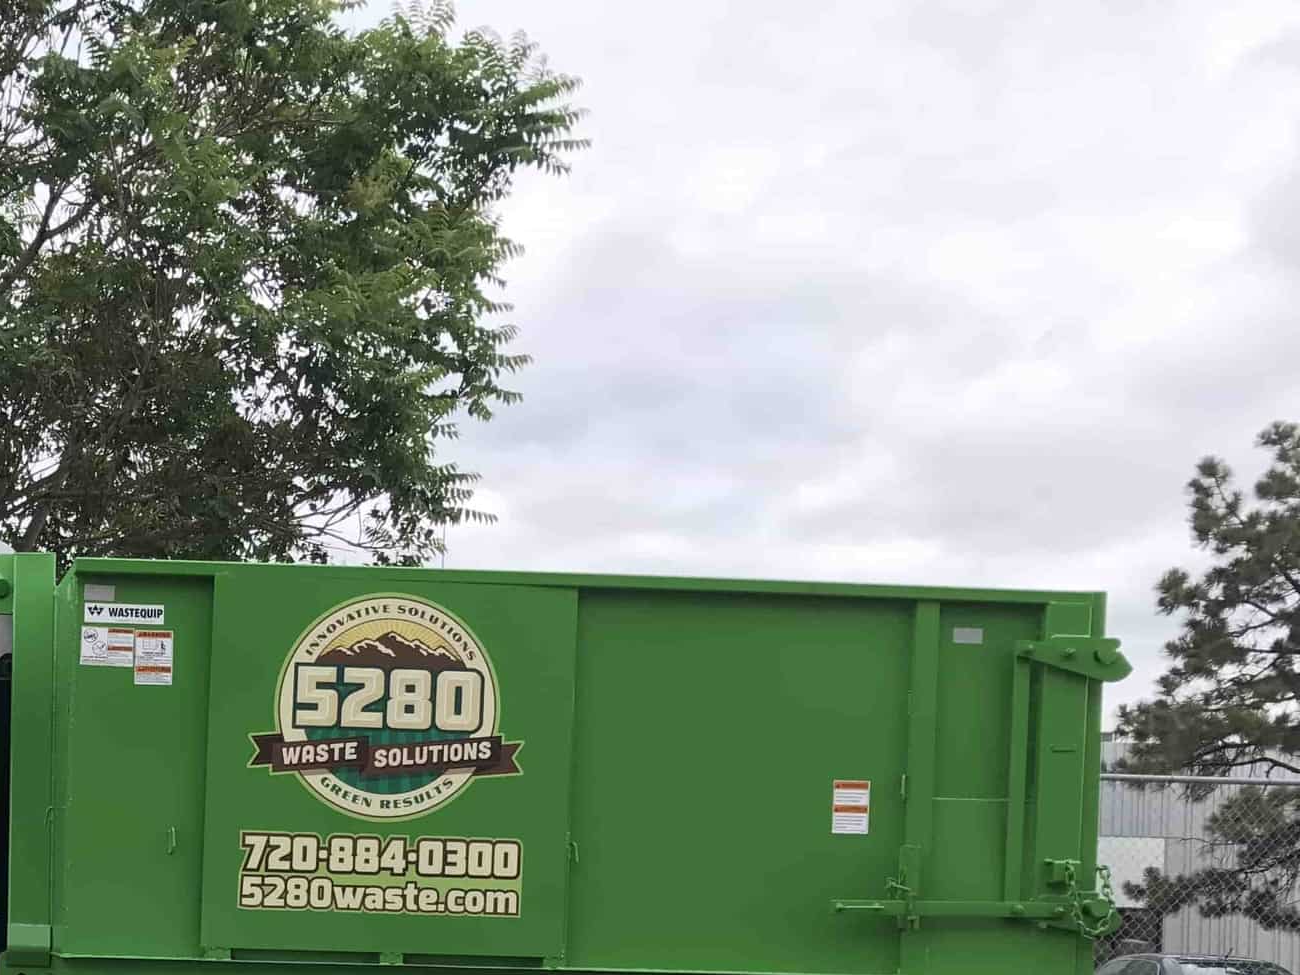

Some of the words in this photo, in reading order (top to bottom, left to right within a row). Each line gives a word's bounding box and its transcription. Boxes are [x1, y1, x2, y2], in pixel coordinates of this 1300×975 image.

[108, 607, 164, 618] WASTEQUIP
[305, 604, 391, 656] INNOVATIVE
[397, 604, 477, 661] SOLUTIONS
[293, 662, 485, 733] 5280
[281, 741, 358, 765] WASTE
[373, 741, 491, 768] SOLUTIONS
[320, 776, 372, 808] GREEN
[379, 777, 454, 809] RESULTS
[240, 875, 518, 915] 5280waste.com
